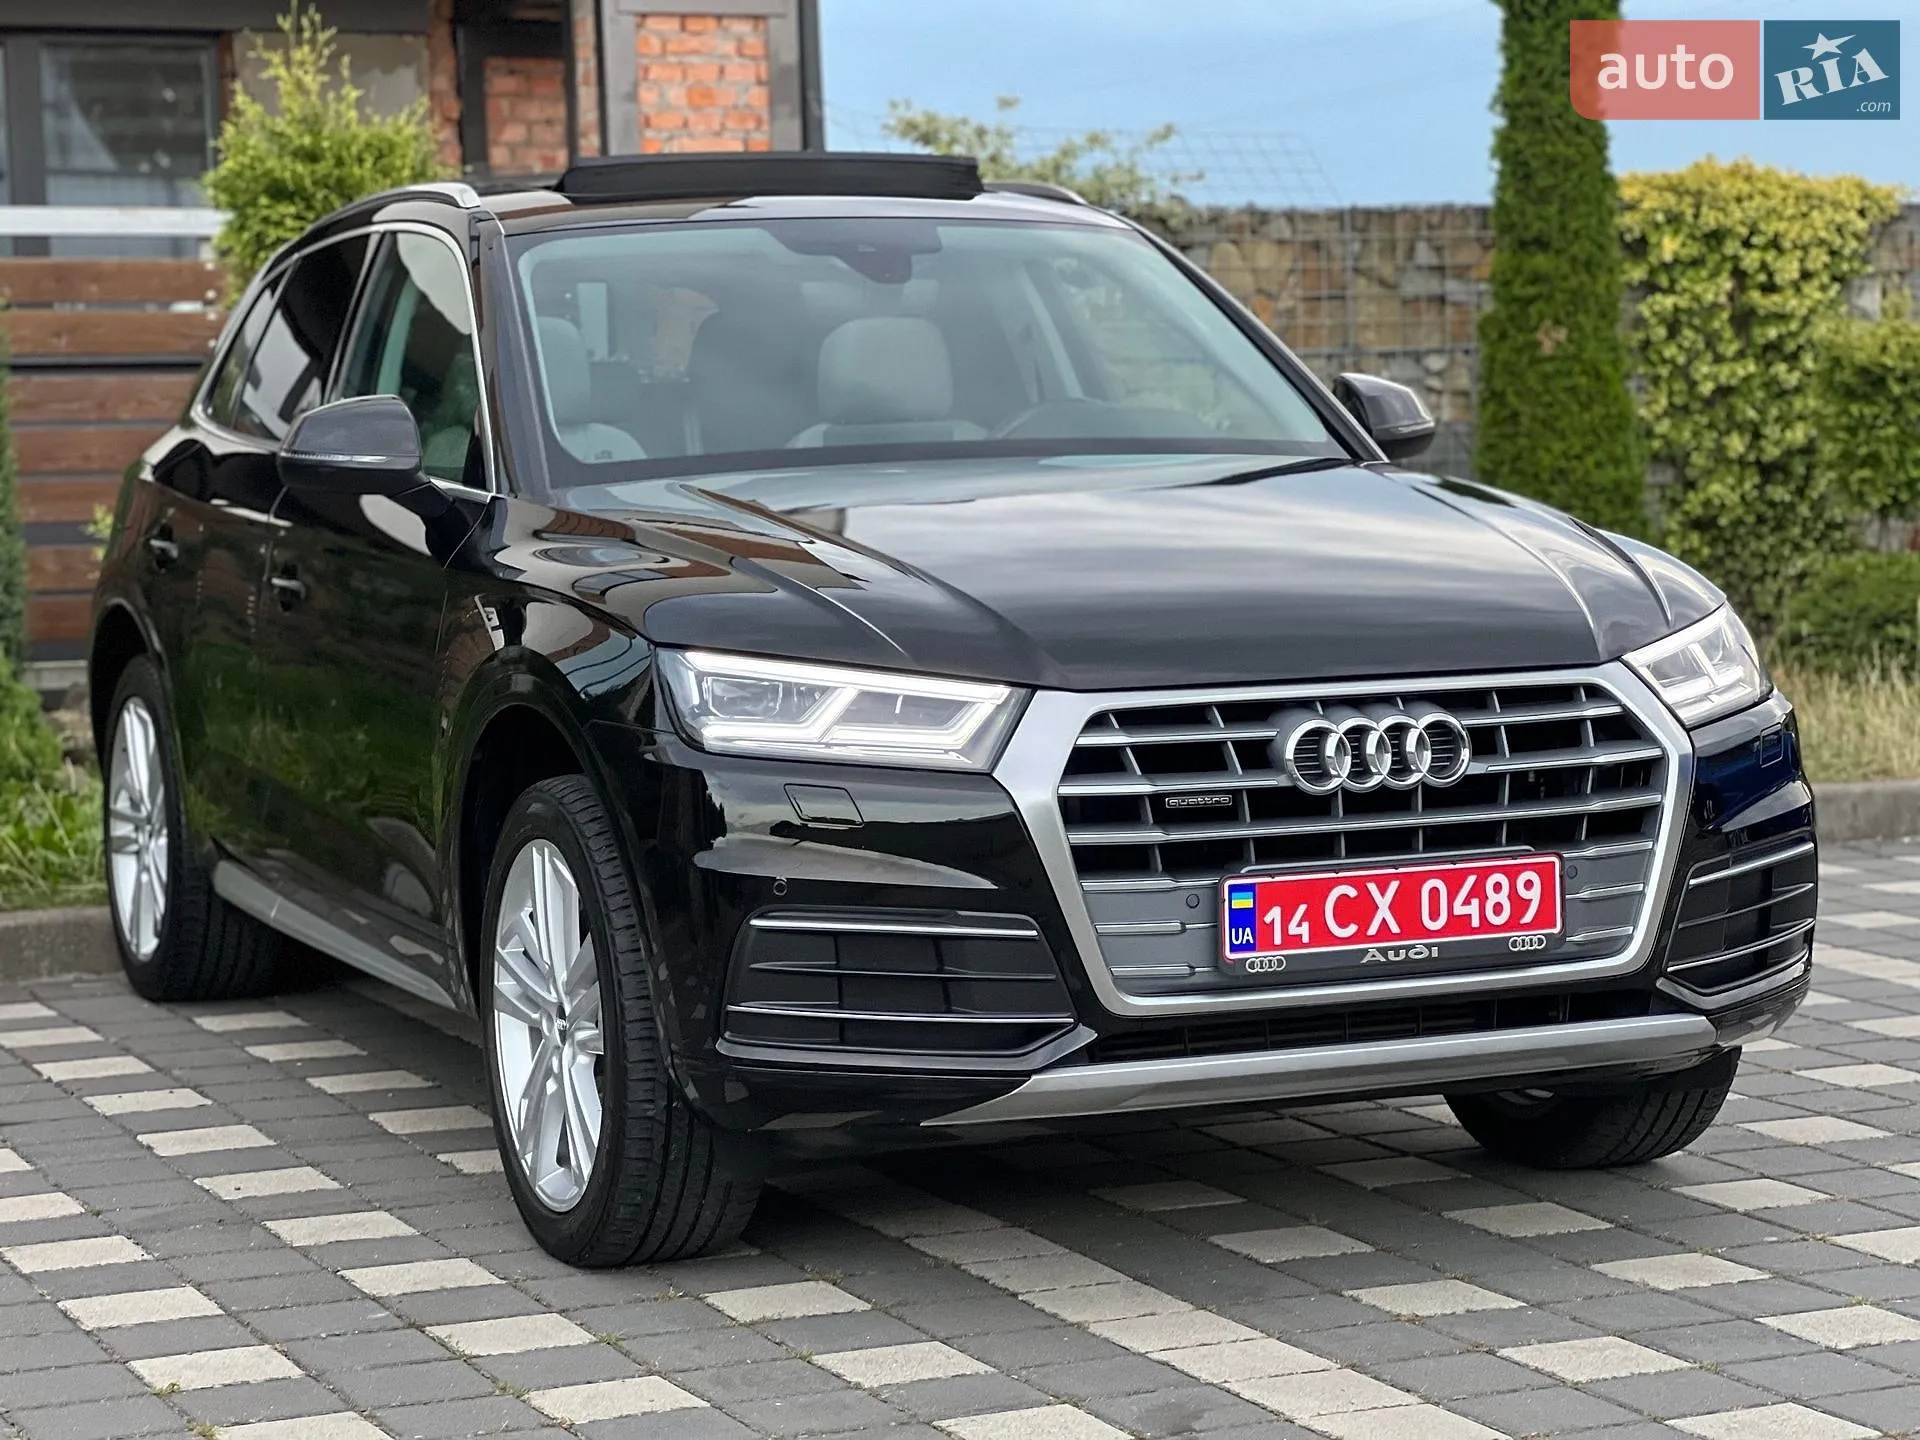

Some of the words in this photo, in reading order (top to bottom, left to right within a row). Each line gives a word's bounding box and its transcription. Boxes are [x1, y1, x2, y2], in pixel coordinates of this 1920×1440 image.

[1263, 904, 1309, 945] 14
[1420, 870, 1542, 931] 0489
[1231, 927, 1254, 945] UA
[1360, 946, 1438, 963] Audi
